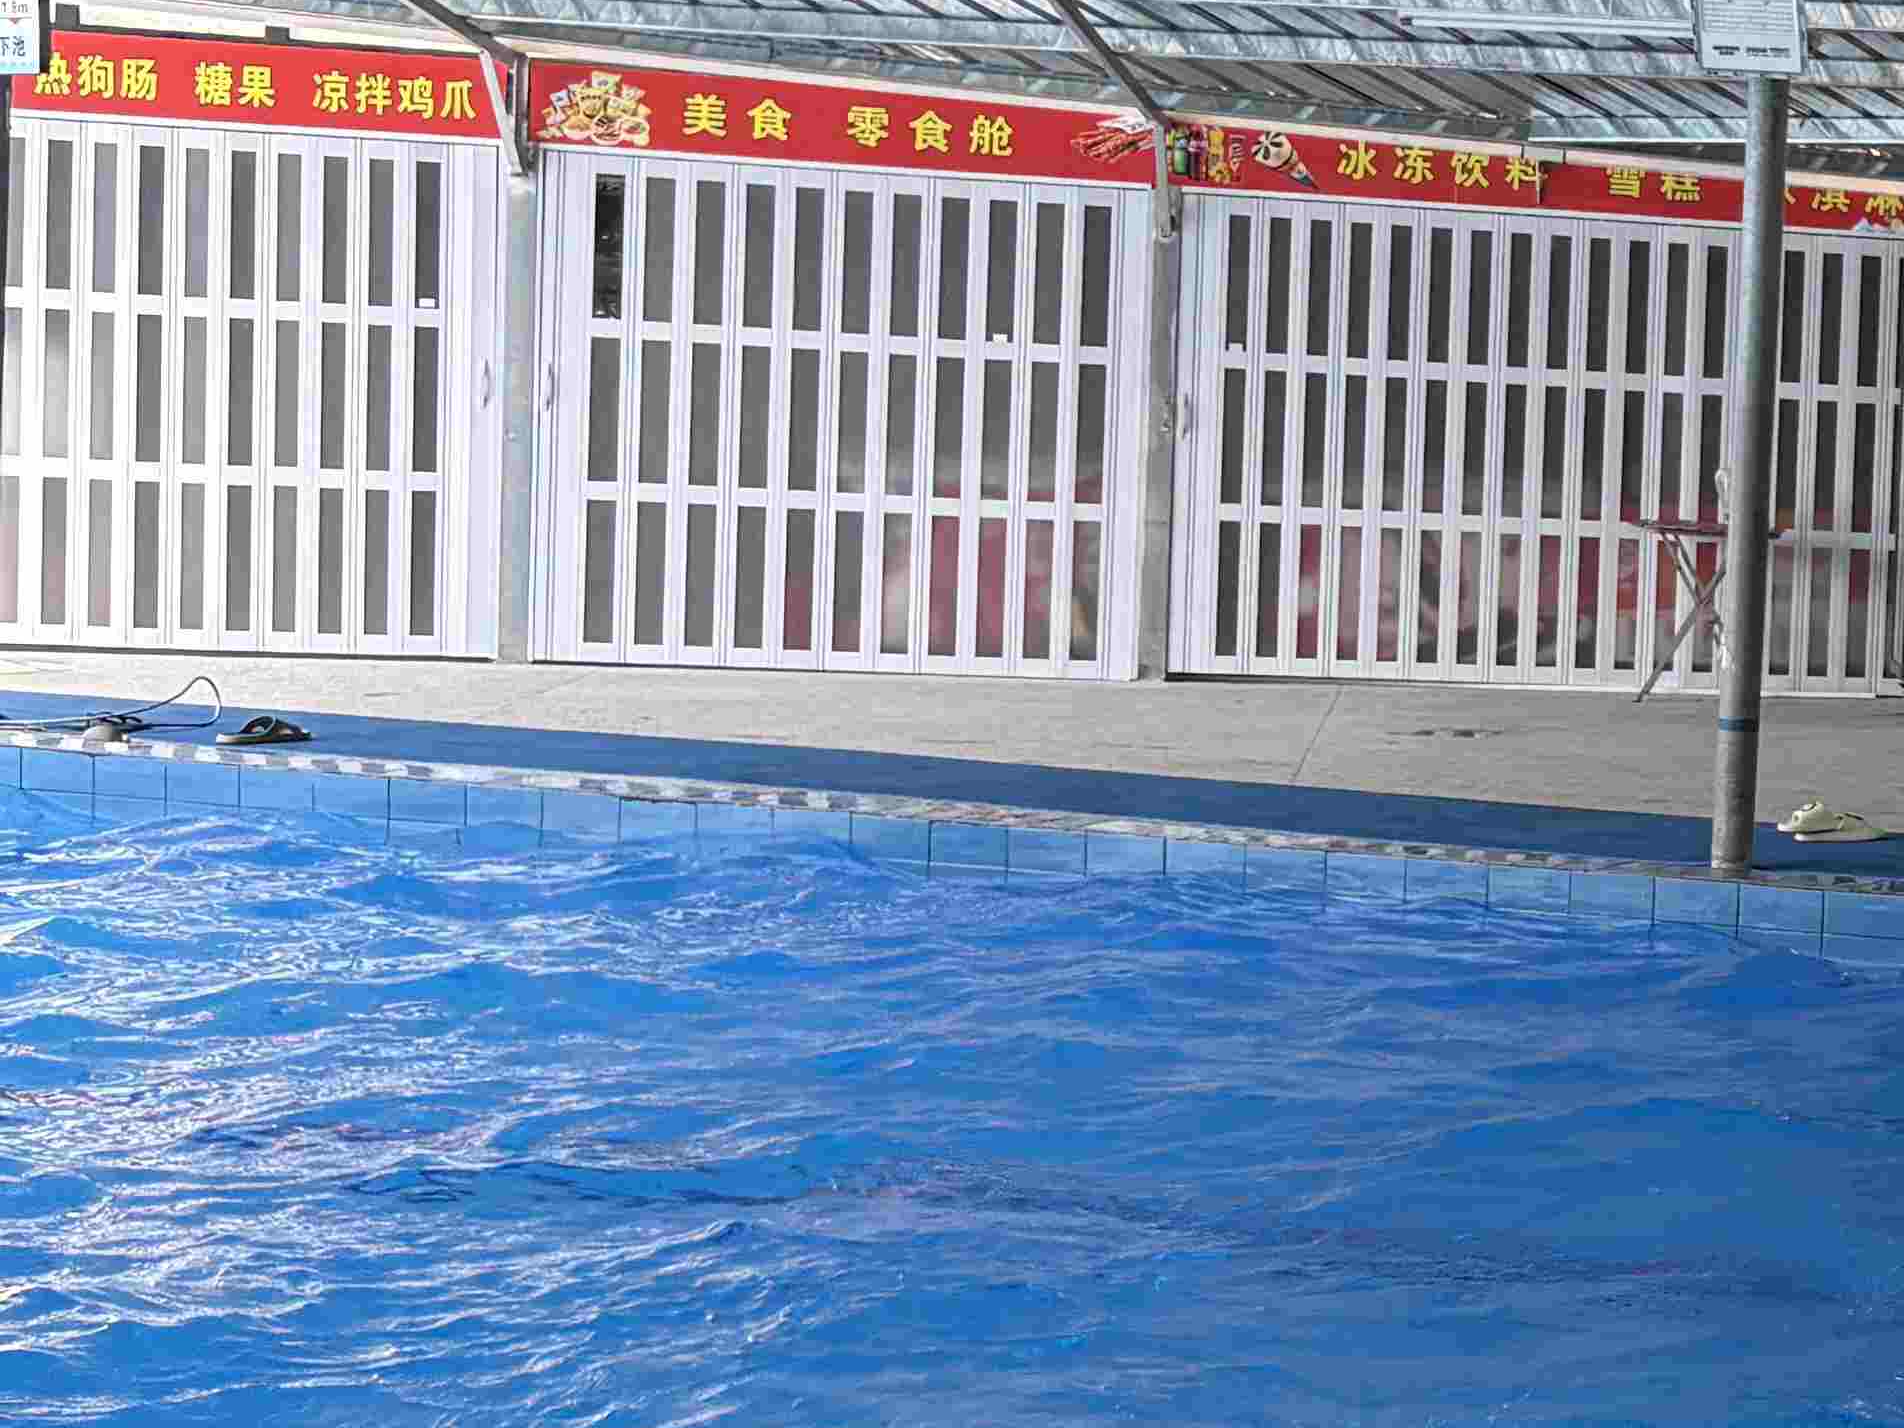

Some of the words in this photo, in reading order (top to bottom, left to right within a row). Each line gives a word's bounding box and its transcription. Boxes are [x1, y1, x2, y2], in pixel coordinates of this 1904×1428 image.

[34, 52, 158, 103] 热狗肠
[194, 63, 275, 110] 糖果
[311, 70, 477, 122] 凉拌鸡爪
[684, 93, 792, 143] 美食
[846, 105, 1015, 158] 零食舱
[1337, 142, 1551, 190] 冰冻饮料
